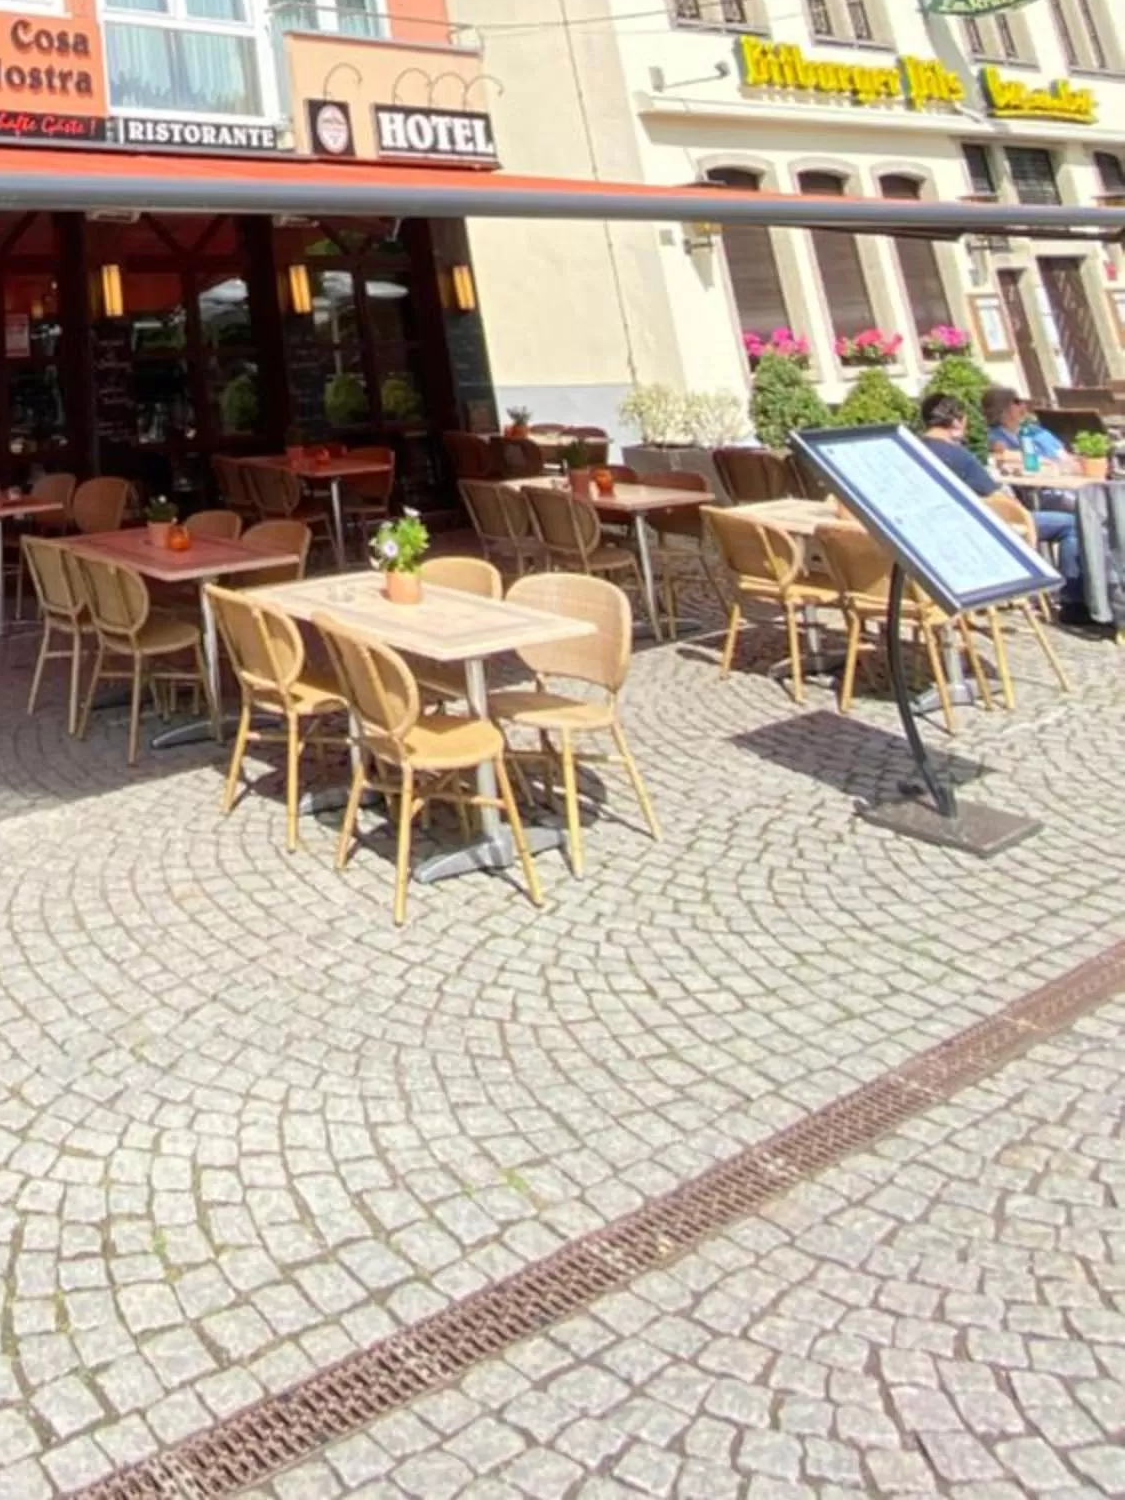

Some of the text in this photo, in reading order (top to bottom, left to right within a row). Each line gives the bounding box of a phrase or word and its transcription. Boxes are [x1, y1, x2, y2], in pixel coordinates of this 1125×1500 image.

[10, 18, 90, 57] Cosa
[128, 120, 275, 148] RISTORANTE
[377, 111, 495, 155] HOTEL
